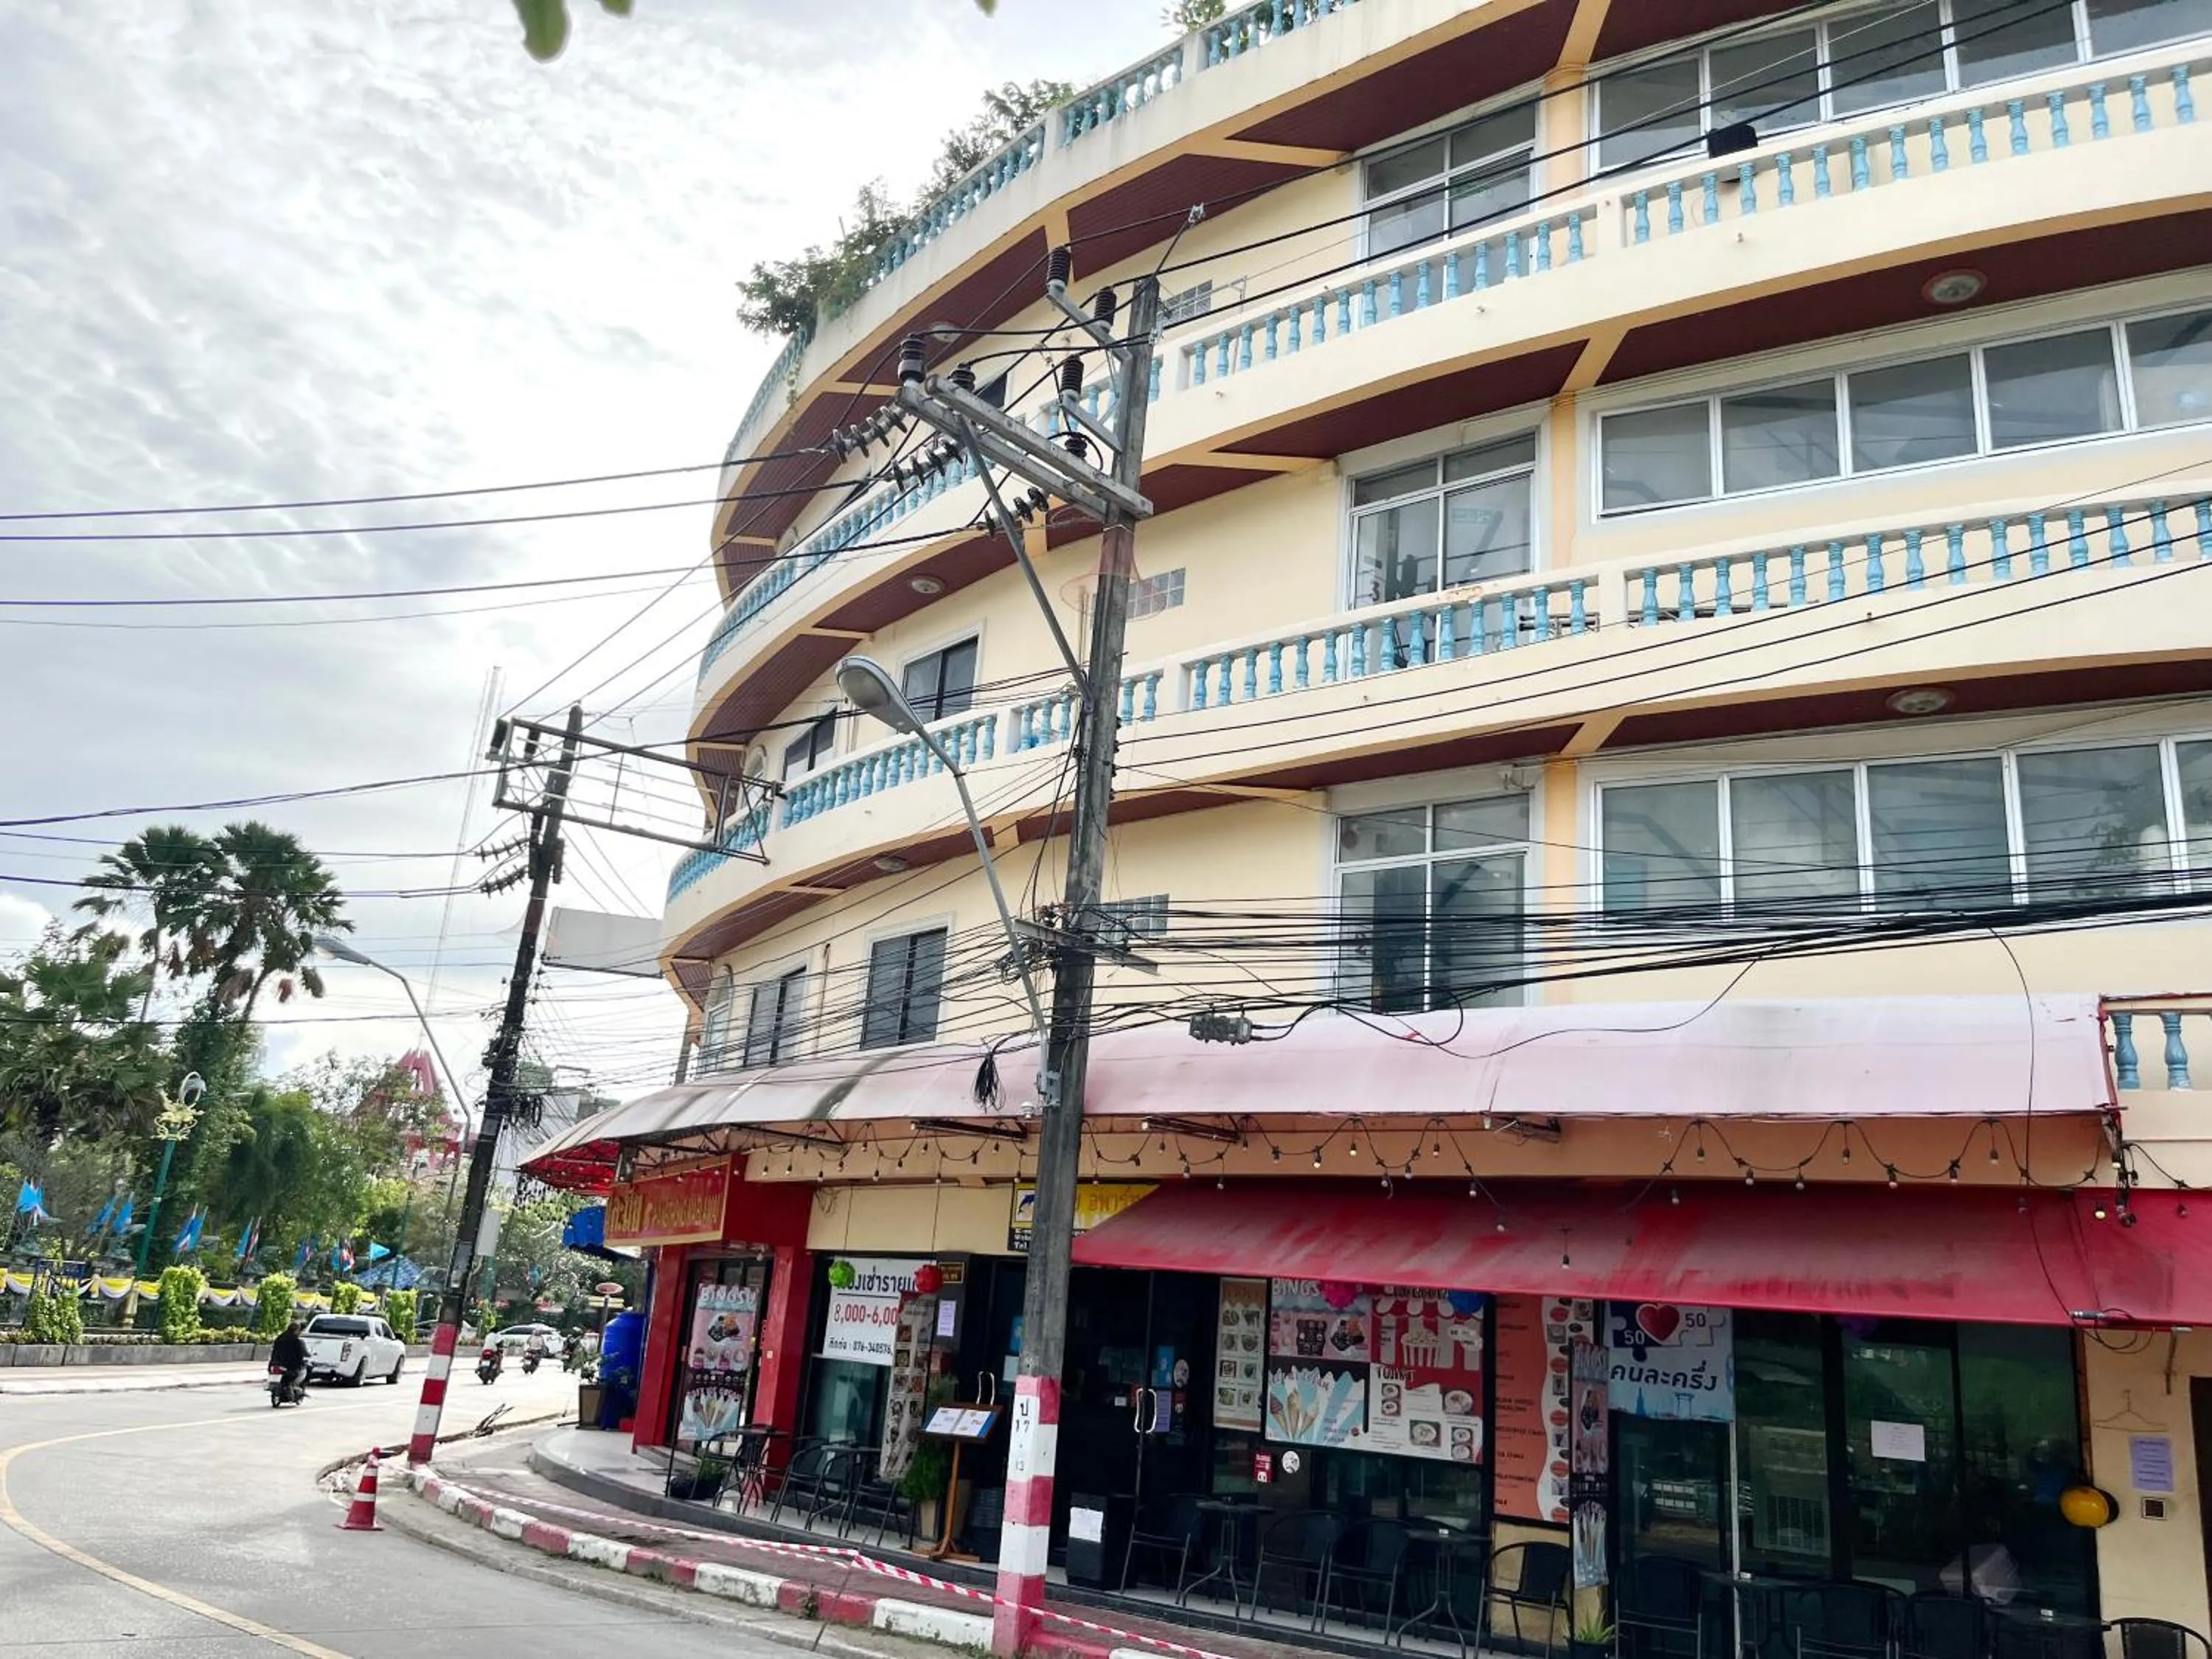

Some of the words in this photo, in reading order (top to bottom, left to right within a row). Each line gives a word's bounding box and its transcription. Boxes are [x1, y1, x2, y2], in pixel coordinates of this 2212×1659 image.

[1272, 1279, 1321, 1296] BINGS
[834, 1303, 897, 1327] 8,000-6,00
[1685, 1313, 1706, 1328] 50
[1624, 1330, 1646, 1345] 50
[1610, 1360, 1718, 1391] คนละครึ่ง
